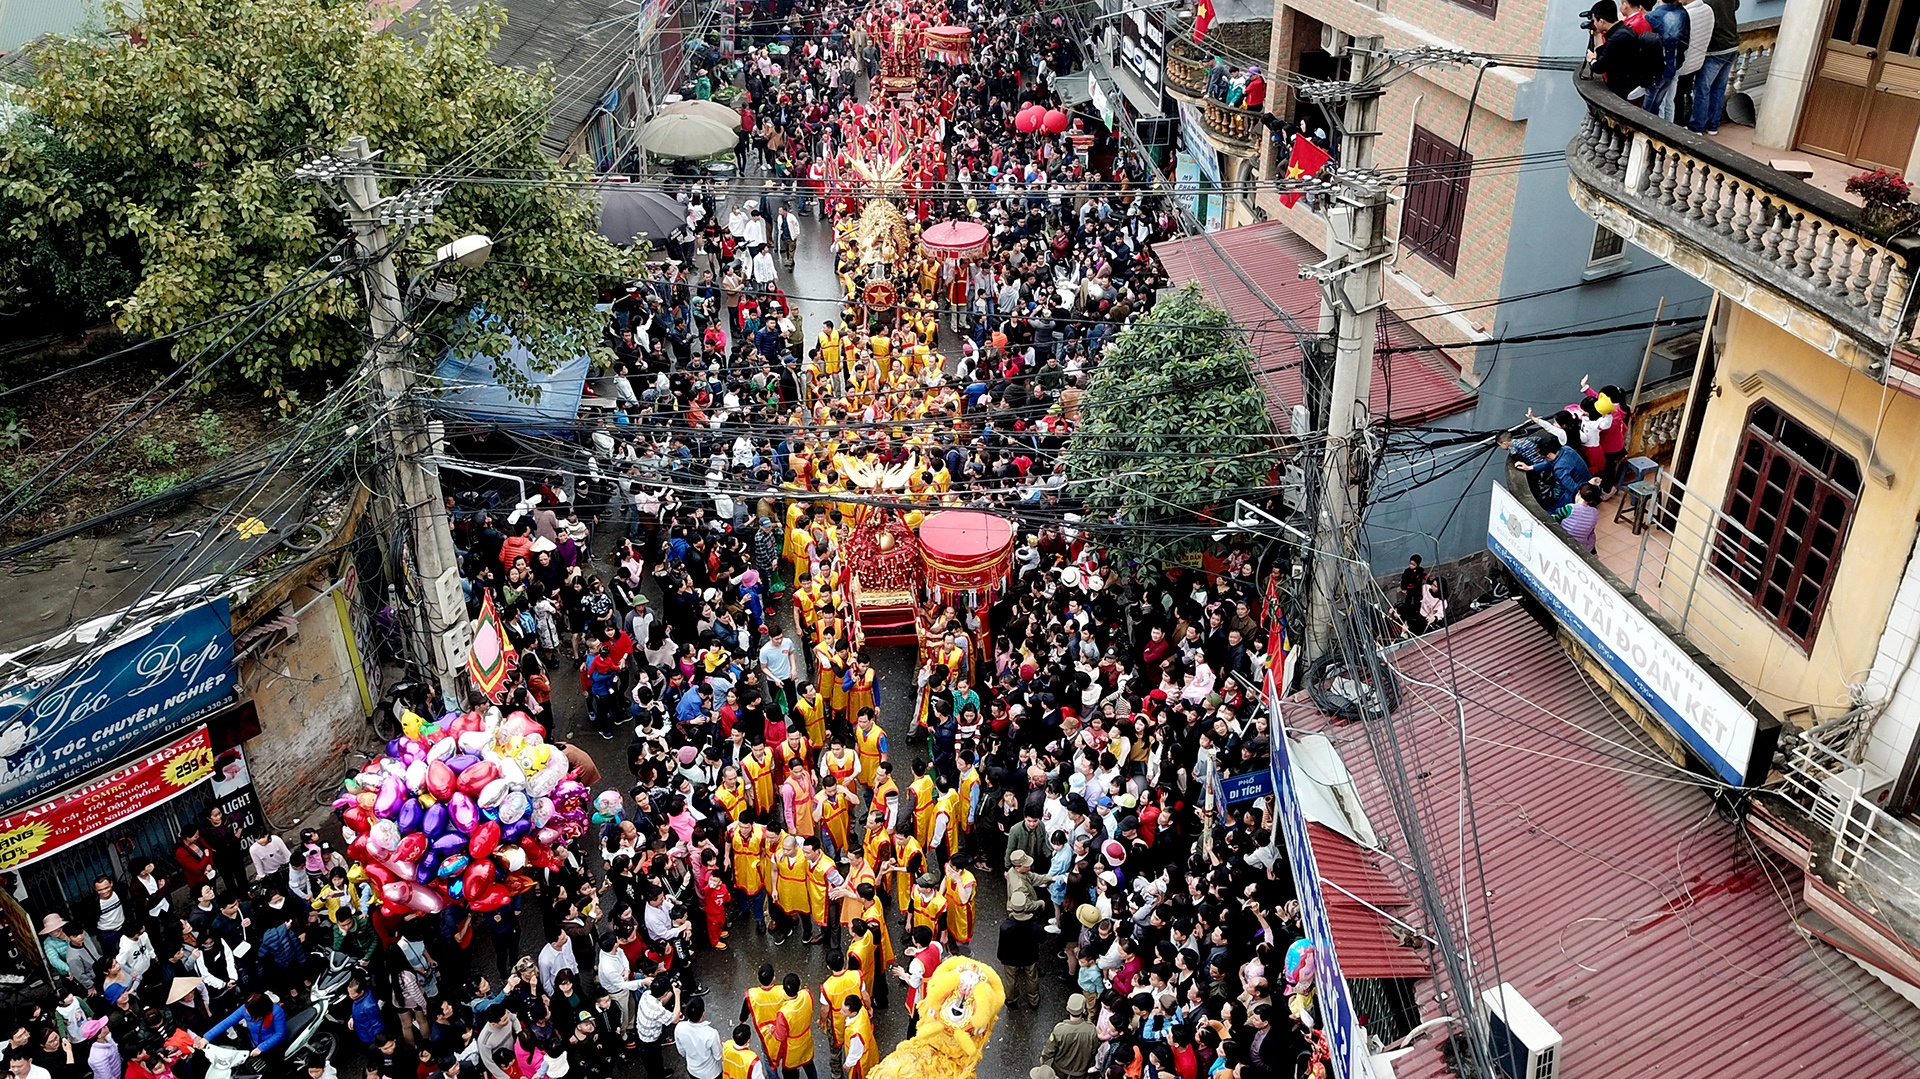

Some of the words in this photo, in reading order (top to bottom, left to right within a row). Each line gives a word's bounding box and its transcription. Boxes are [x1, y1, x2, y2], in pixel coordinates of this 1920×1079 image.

[127, 635, 224, 697] Đẹp
[1539, 551, 1577, 604] VẬN
[1583, 592, 1612, 638] TẢI
[1616, 626, 1680, 703] ĐOÀN
[1685, 692, 1727, 744] KẾT
[1622, 608, 1645, 633] TY
[1651, 635, 1703, 692] TNHH
[52, 737, 87, 761] TÓC
[91, 704, 159, 743] CHUYÊN
[163, 673, 226, 711] NGHIỆP
[175, 757, 200, 780] 299
[83, 782, 128, 806] COMBO
[222, 792, 251, 815] LIGHT
[1229, 789, 1239, 800] DI
[1241, 784, 1262, 797] TÍCH
